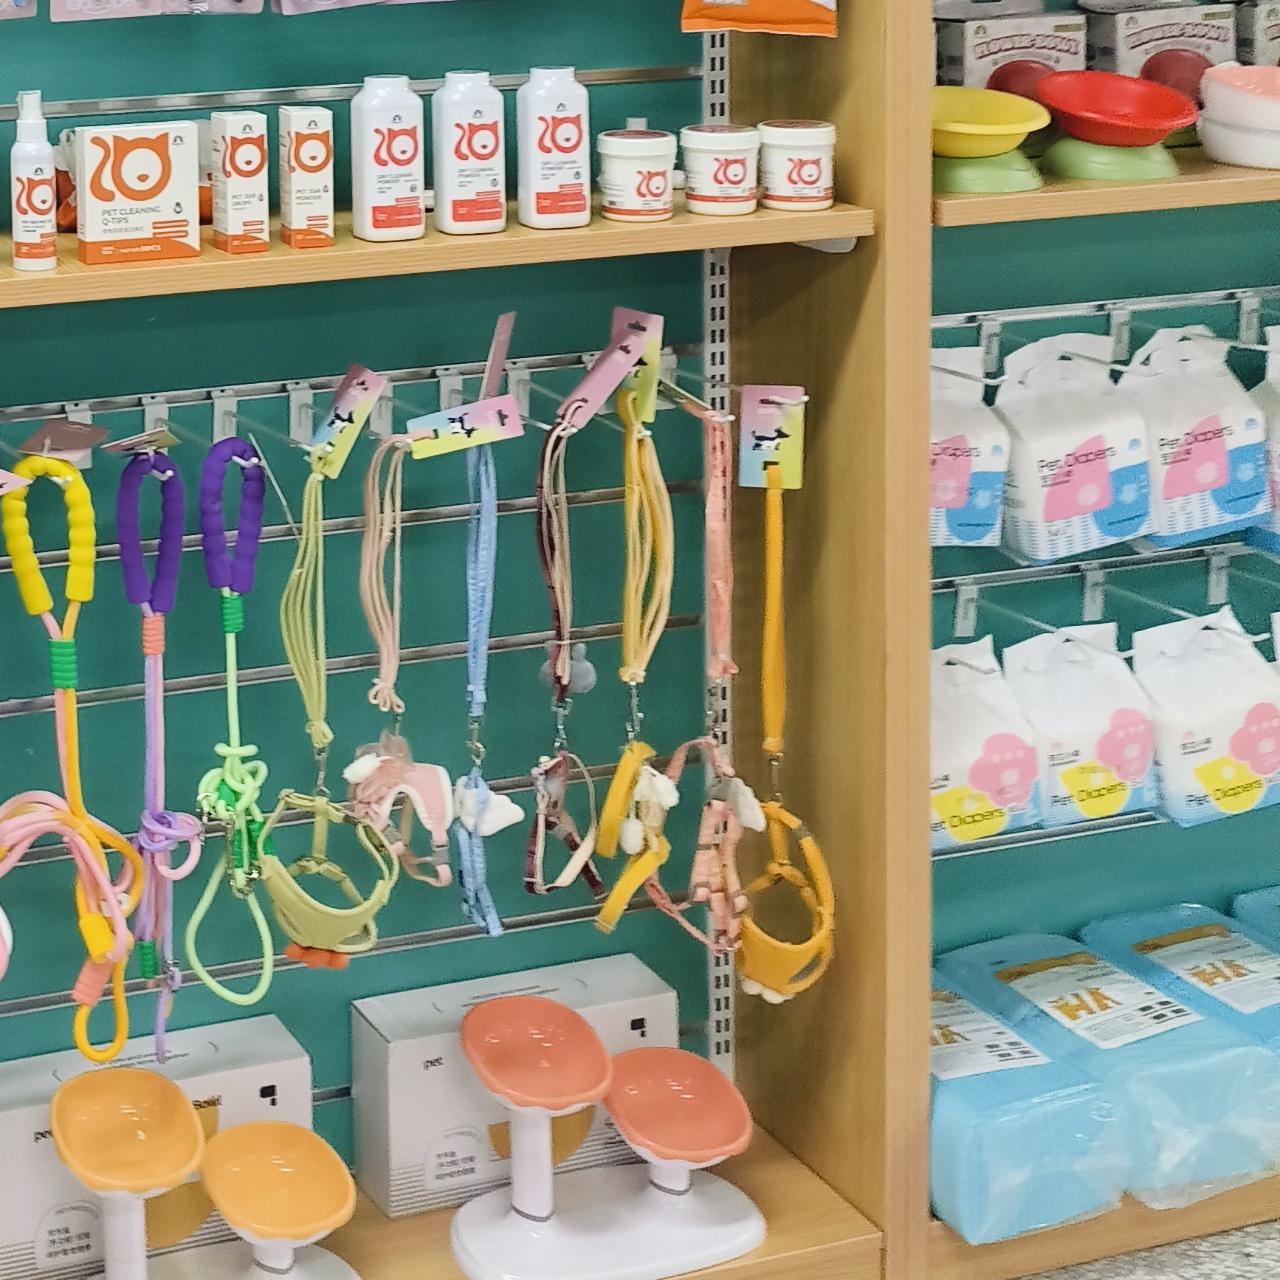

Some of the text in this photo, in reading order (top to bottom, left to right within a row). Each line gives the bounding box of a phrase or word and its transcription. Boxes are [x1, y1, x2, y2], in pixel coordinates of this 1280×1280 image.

[102, 206, 162, 217] PET CLEANING
[102, 217, 129, 226] Q-TIPS
